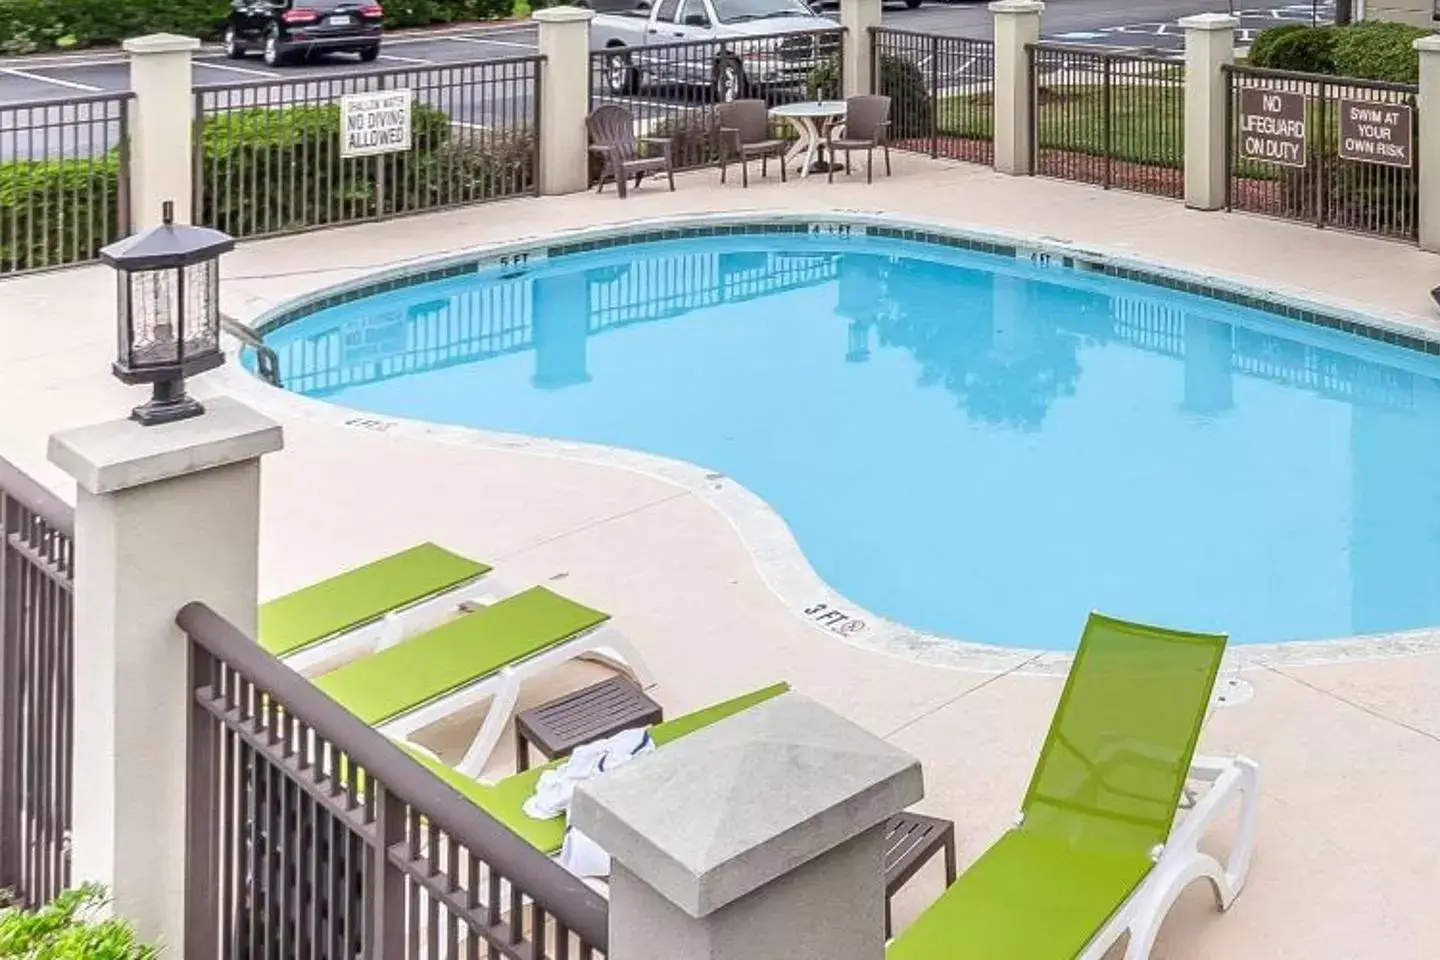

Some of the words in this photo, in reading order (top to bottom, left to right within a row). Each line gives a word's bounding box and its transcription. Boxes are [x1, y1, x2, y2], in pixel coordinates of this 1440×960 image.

[1263, 94, 1282, 113] NO
[348, 113, 363, 131] NO
[367, 108, 404, 129] DIVING
[1241, 113, 1305, 138] LIFEGUARD
[1350, 107, 1382, 124] SWIM
[1383, 112, 1400, 126] AT
[348, 127, 404, 149] ALLOWED
[1358, 123, 1392, 141] YOUR
[1245, 136, 1264, 155] ON
[1266, 139, 1300, 160] DUTY
[1345, 137, 1375, 155] OWN
[1376, 142, 1406, 159] RISK
[513, 251, 529, 266] FT
[803, 603, 828, 615] 3
[815, 609, 849, 626] FT
